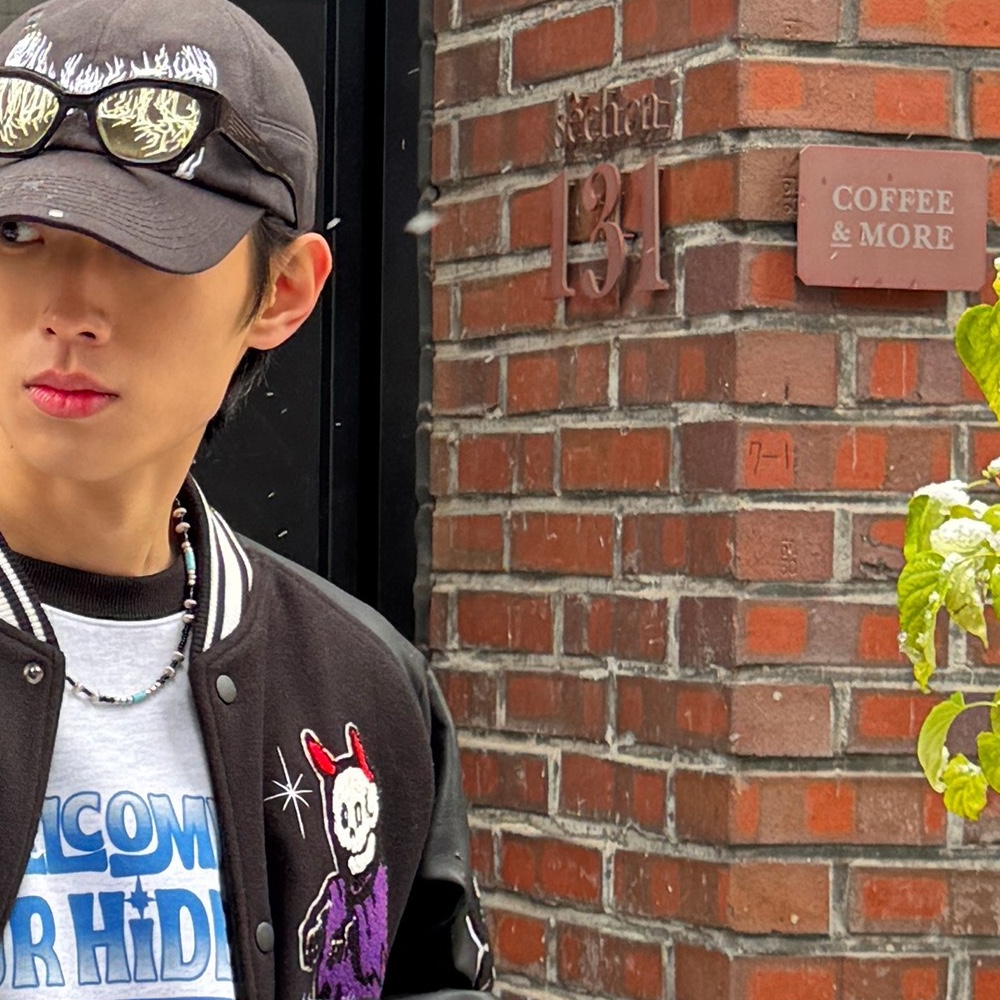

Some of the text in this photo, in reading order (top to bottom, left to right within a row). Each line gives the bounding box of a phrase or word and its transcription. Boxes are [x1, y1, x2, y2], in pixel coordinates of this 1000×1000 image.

[546, 155, 670, 299] 131
[832, 185, 954, 215] COFFEE
[830, 220, 954, 250] & MORE
[26, 790, 218, 878] LCOM
